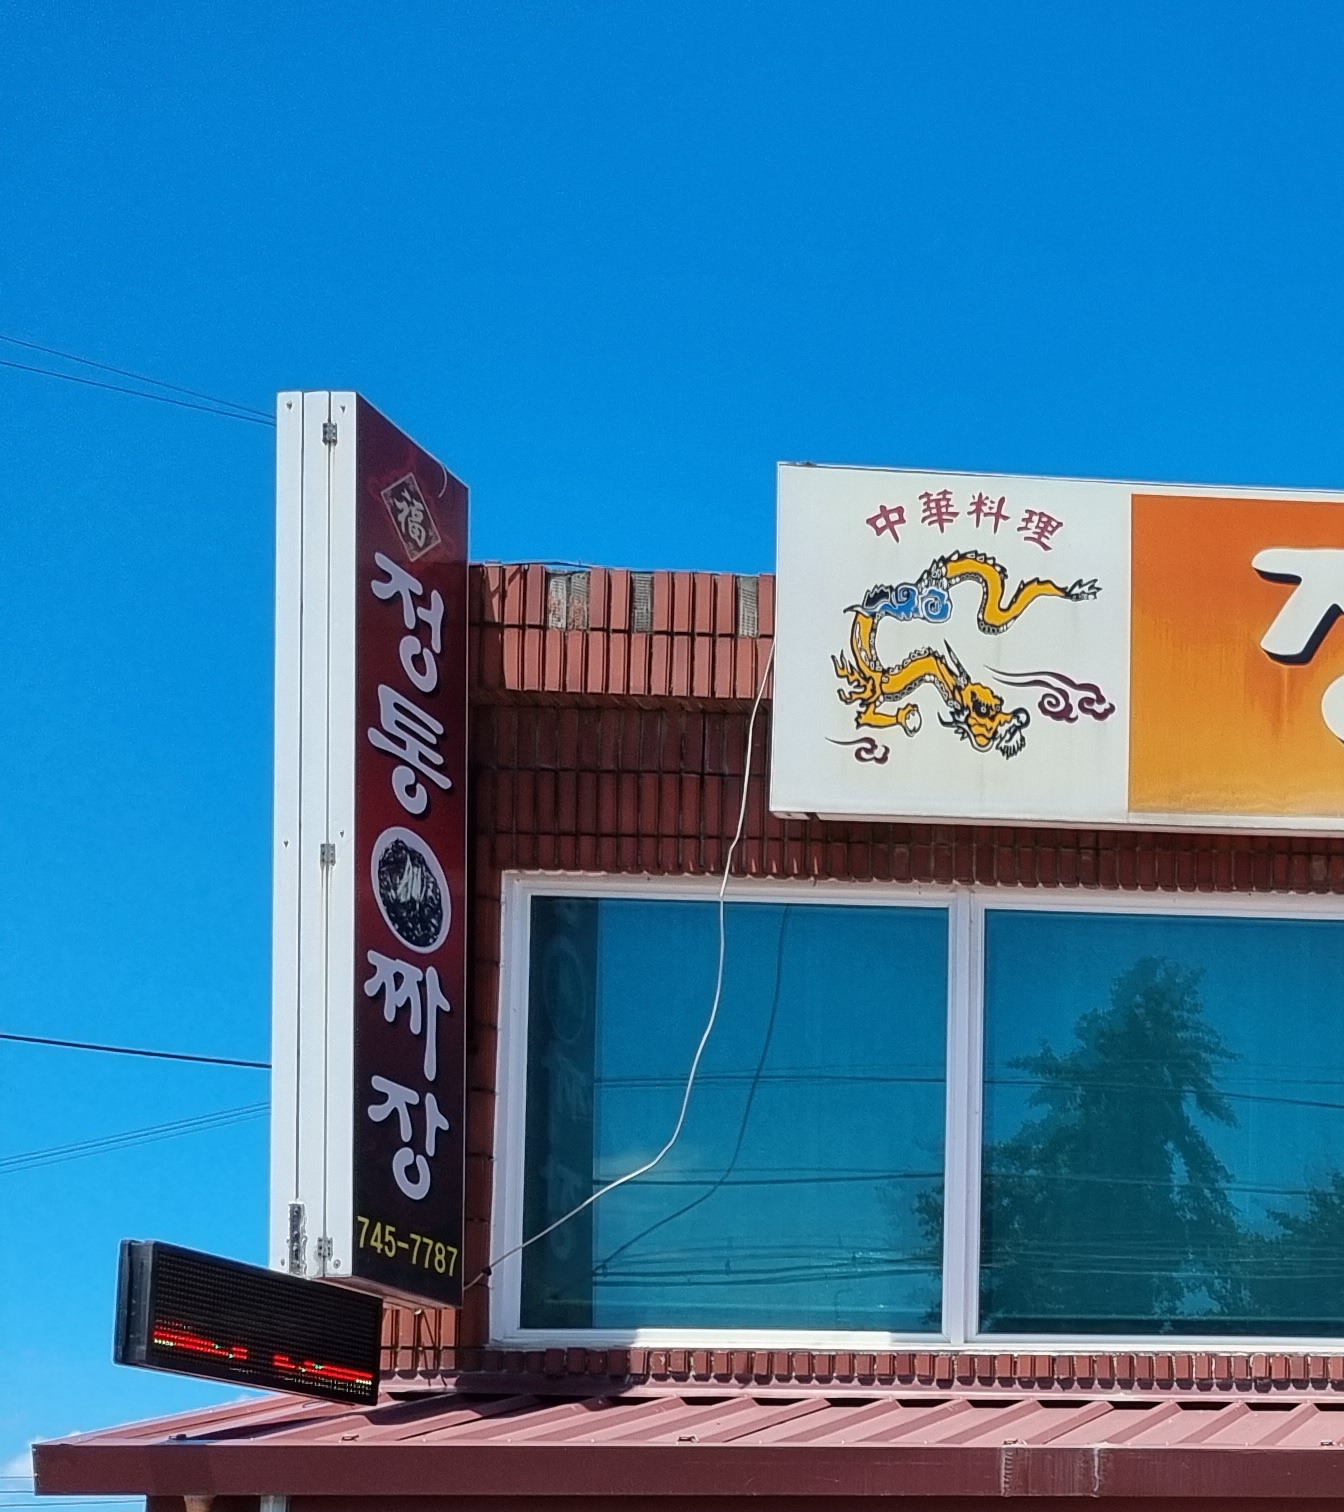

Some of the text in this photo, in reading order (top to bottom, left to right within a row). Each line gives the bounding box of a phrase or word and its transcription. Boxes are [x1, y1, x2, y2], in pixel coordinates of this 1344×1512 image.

[866, 488, 1064, 551] 中華料理
[364, 551, 453, 1201] 정통 짜장
[357, 1215, 459, 1278] 745-7787
